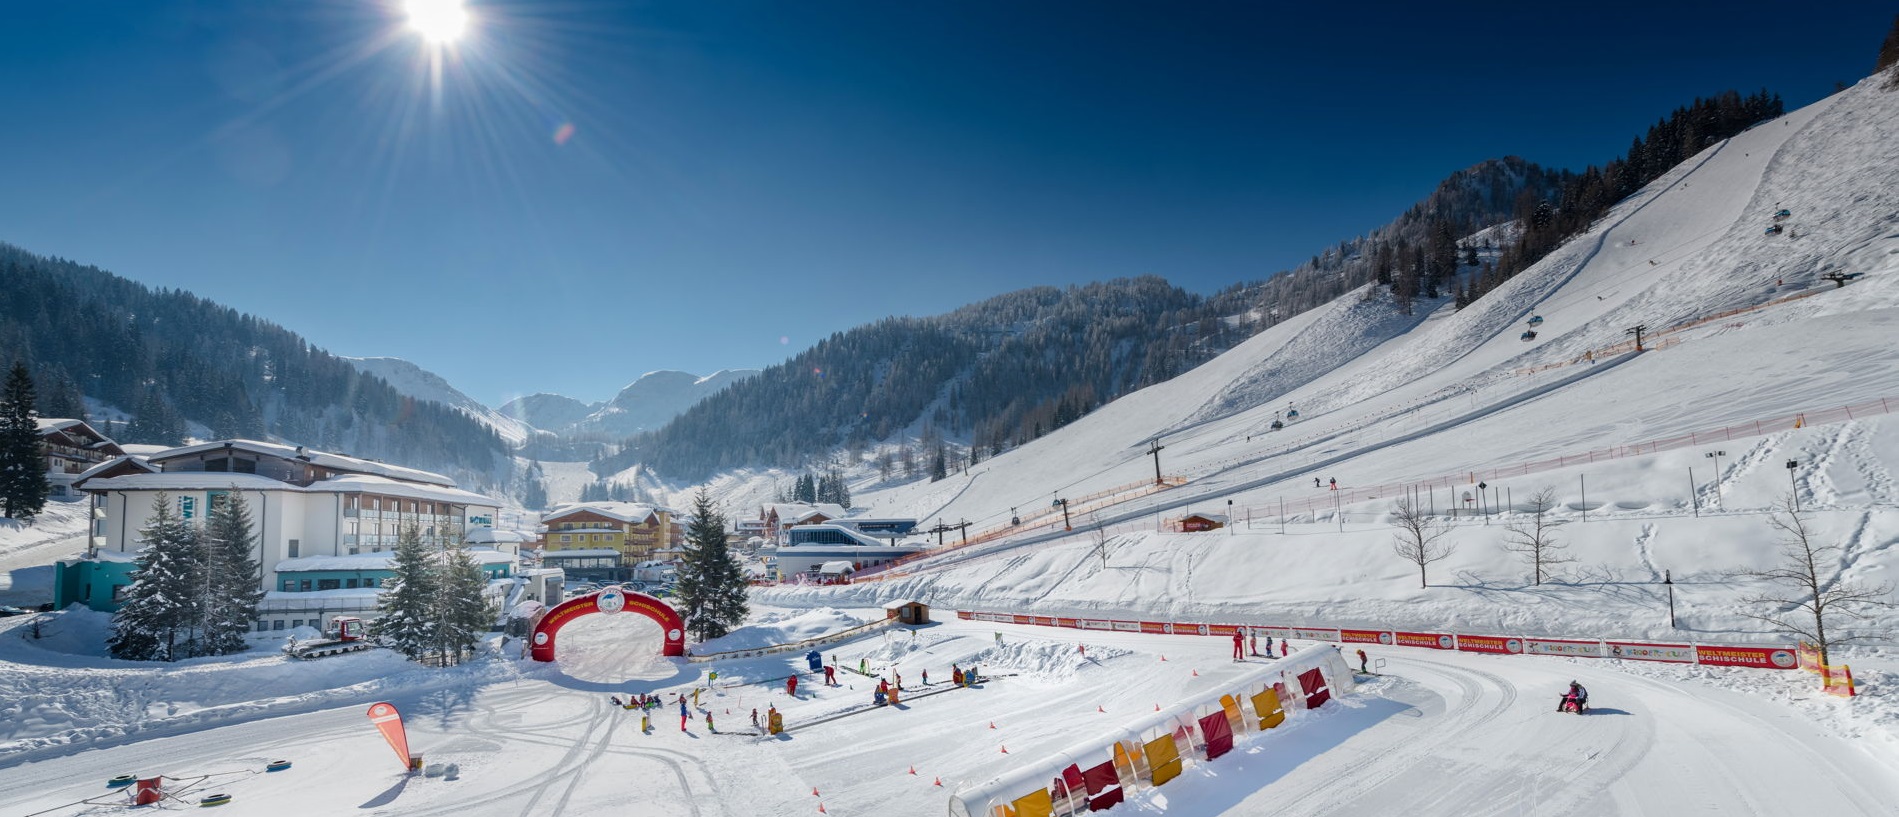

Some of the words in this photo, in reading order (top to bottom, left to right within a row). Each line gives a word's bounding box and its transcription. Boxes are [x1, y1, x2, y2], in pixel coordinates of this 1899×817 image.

[548, 601, 594, 624] WELTMEISTER
[629, 600, 670, 622] SCHISCHULE
[1459, 642, 1504, 650] SCHISCHULE
[1698, 649, 1766, 658] WELTMEISTER
[1699, 655, 1767, 664] SCHISCHULE
